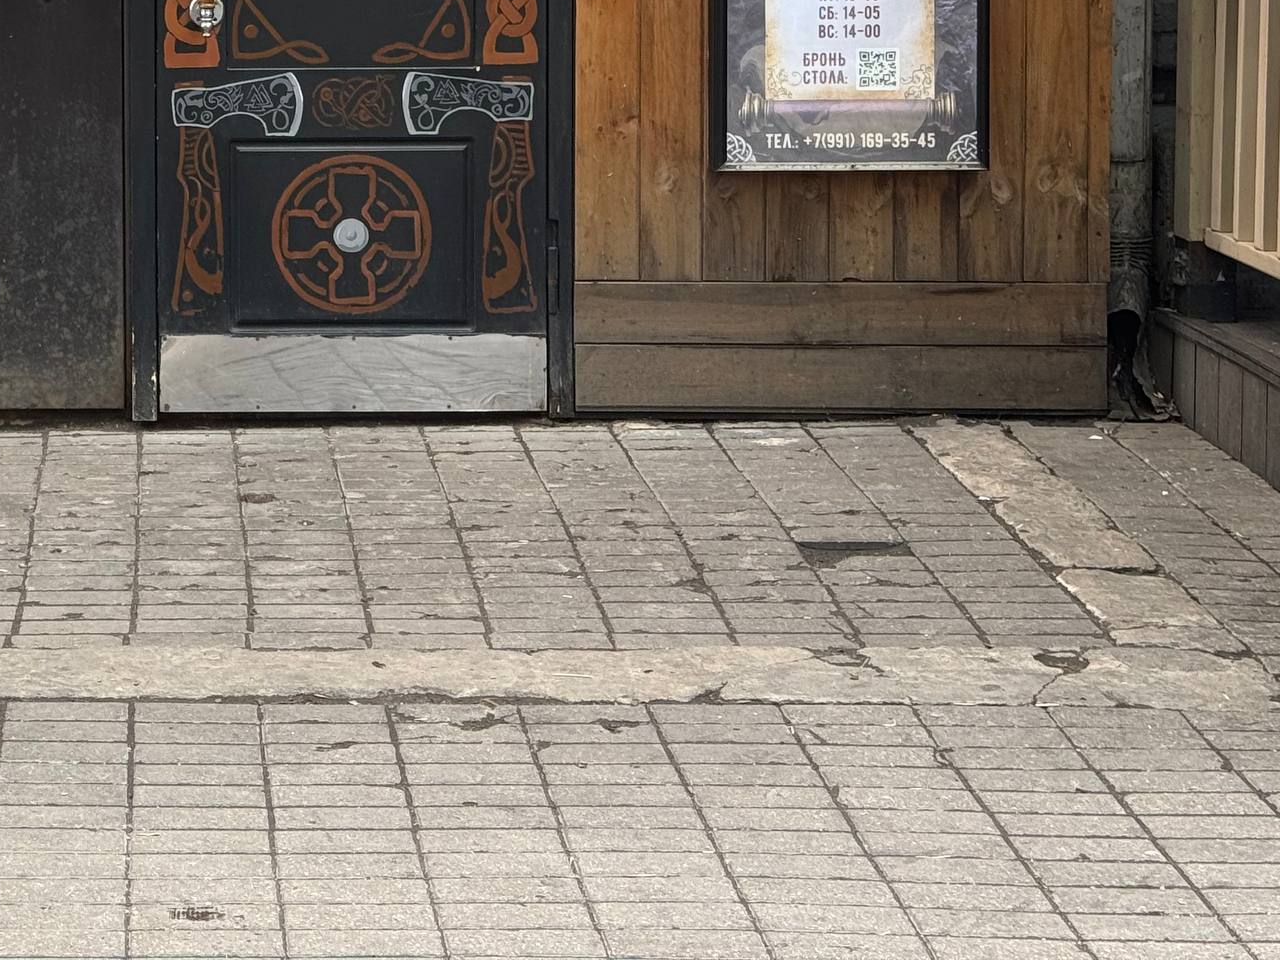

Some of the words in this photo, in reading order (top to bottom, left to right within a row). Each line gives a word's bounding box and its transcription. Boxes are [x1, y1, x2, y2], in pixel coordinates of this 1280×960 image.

[819, 6, 838, 20] СБ:
[843, 6, 880, 19] 14-05
[818, 24, 838, 38] ВС:
[843, 24, 881, 38] 14-00
[803, 52, 846, 67] БРОНЬ
[803, 70, 848, 85] СТОЛА:
[766, 133, 799, 149] ТЕЛ.:
[803, 133, 855, 149] +7(991)
[861, 133, 936, 148] 169-35-45
